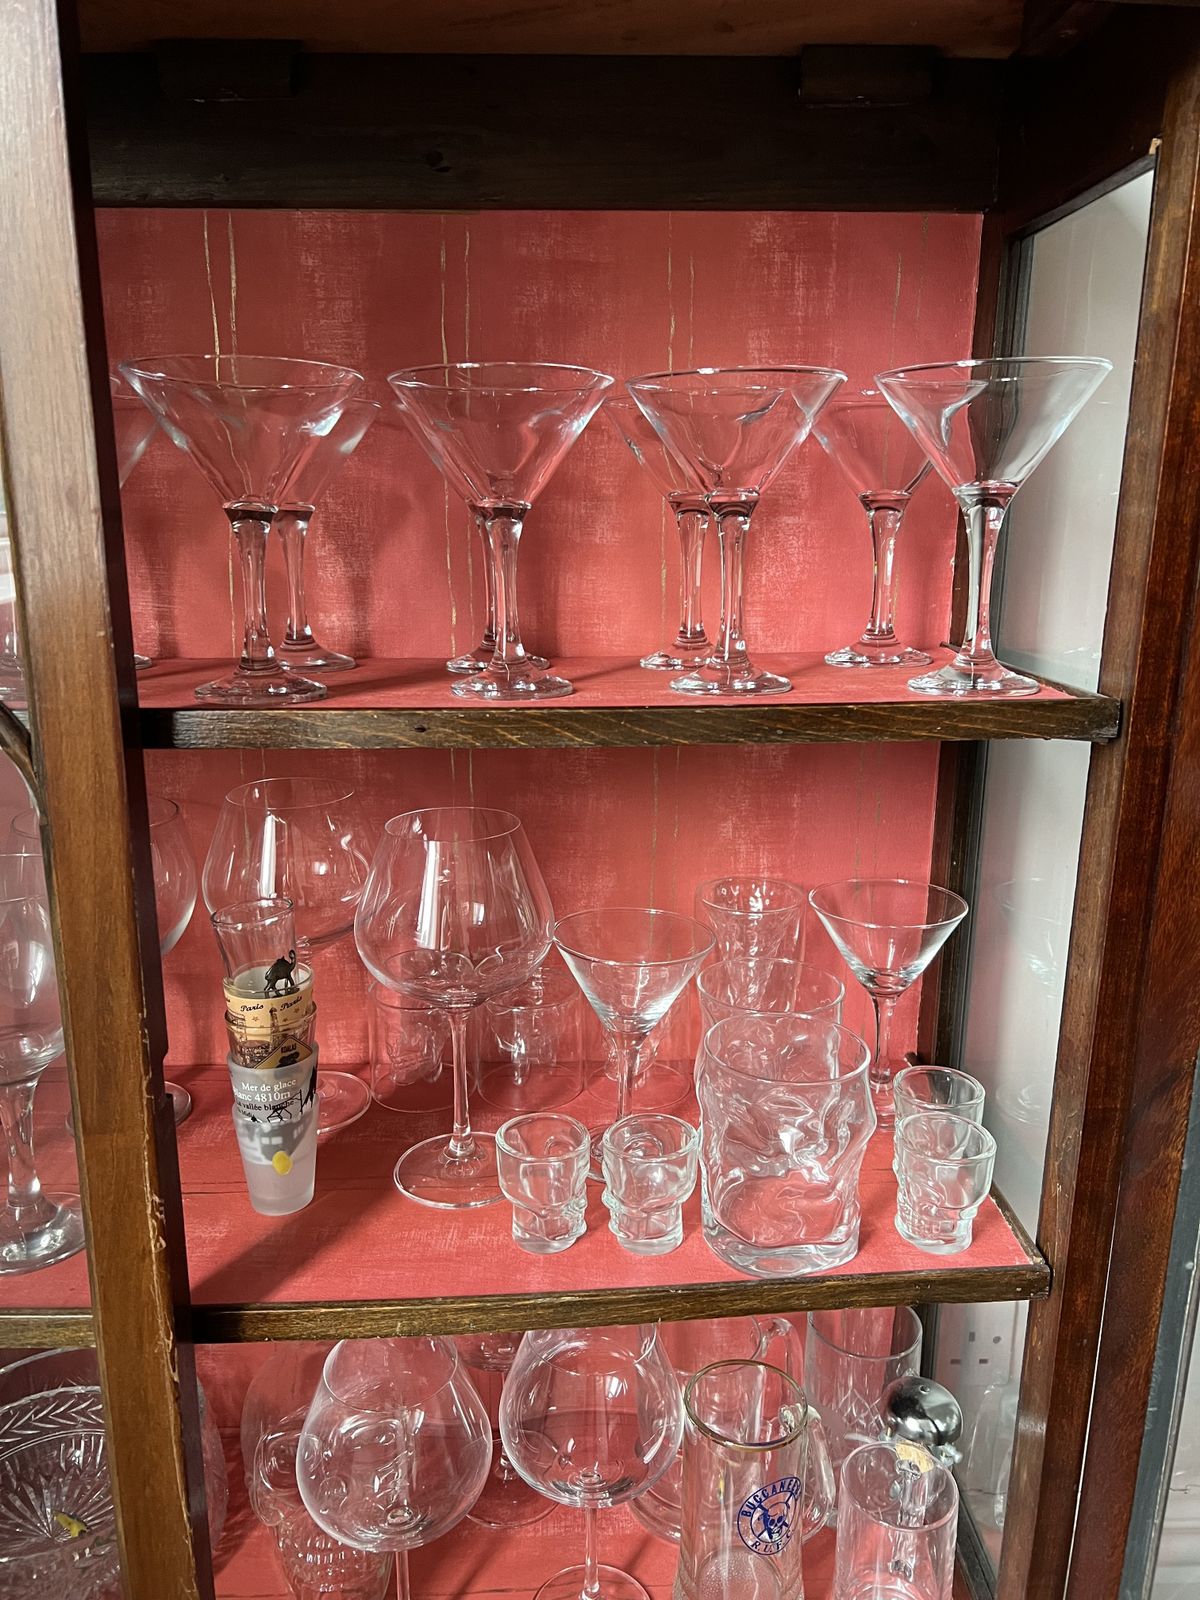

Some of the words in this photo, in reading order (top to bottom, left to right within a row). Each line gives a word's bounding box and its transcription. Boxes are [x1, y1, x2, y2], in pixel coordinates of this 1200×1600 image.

[240, 1003, 264, 1012] Paris
[241, 1082, 258, 1092] Mer
[260, 1083, 271, 1091] de
[273, 1079, 297, 1093] glace
[254, 1090, 291, 1102] 4810m
